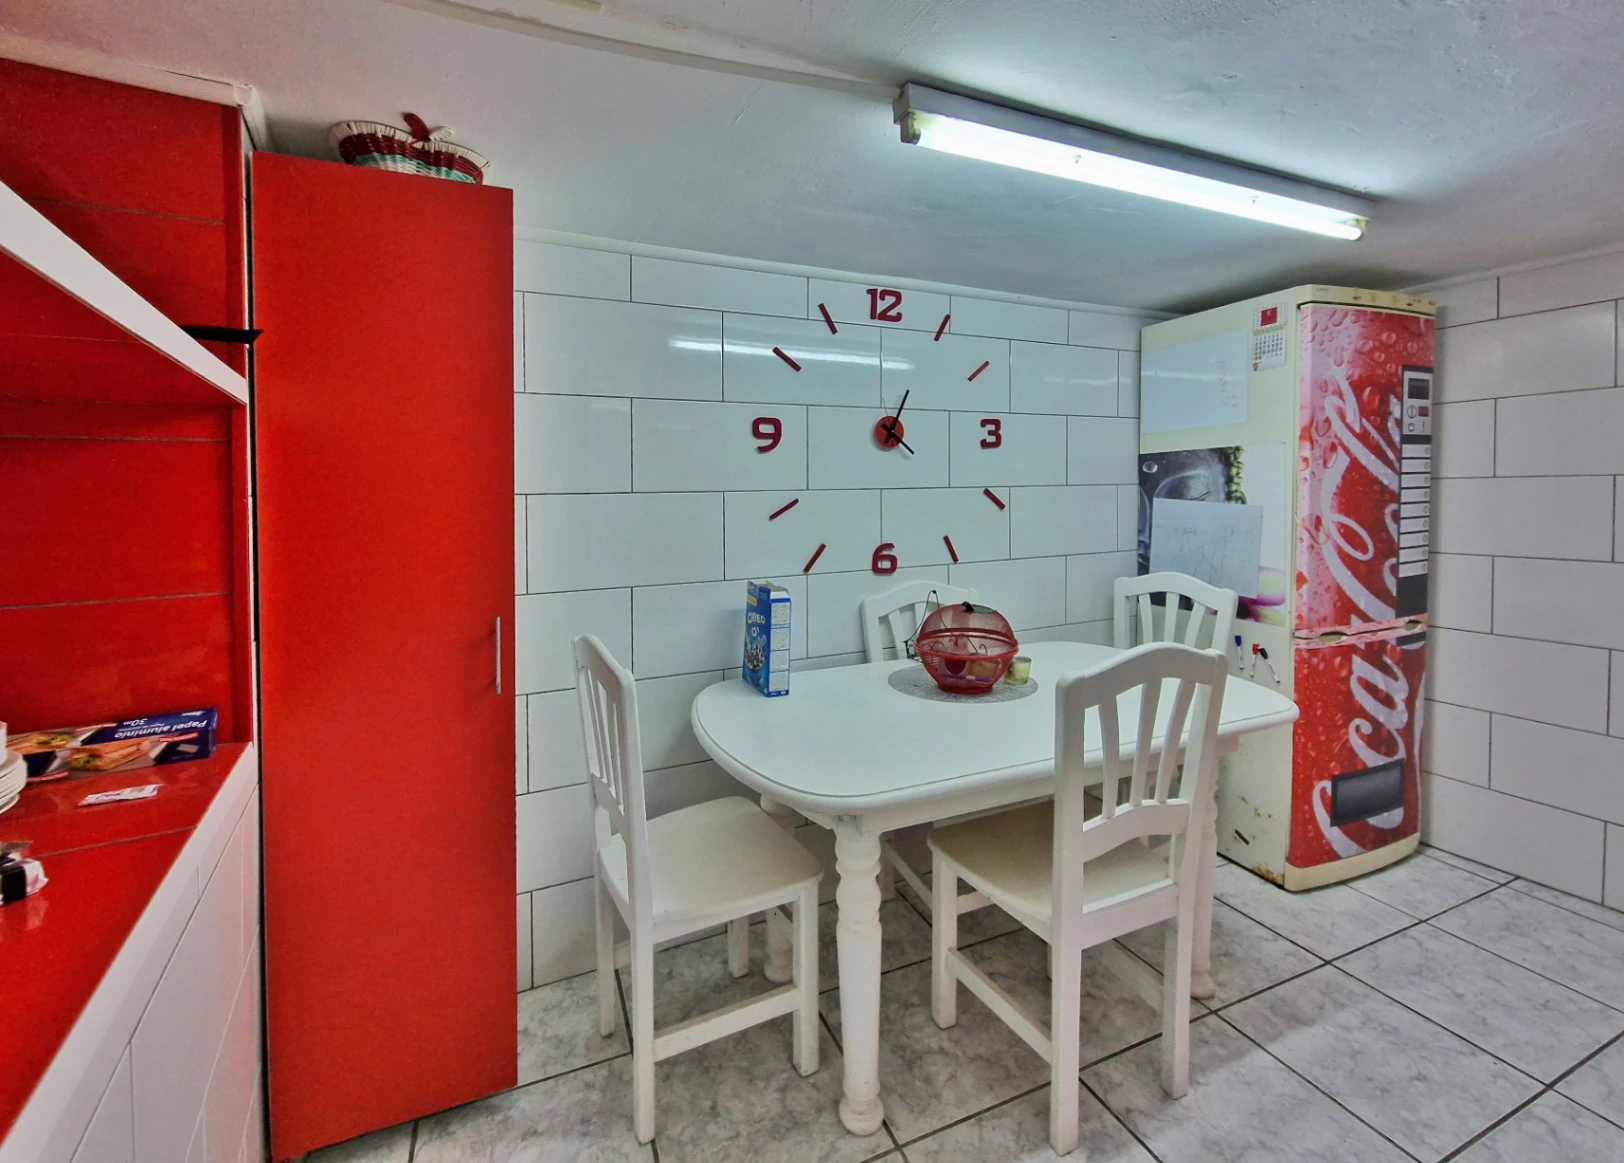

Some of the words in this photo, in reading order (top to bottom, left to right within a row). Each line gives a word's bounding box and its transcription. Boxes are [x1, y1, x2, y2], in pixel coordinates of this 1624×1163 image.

[866, 288, 903, 322] 12
[752, 417, 783, 453] 9
[980, 418, 1002, 449] 3
[872, 543, 898, 575] 6
[747, 611, 766, 625] OREO
[123, 718, 148, 726] 30m
[172, 720, 208, 731] Papel
